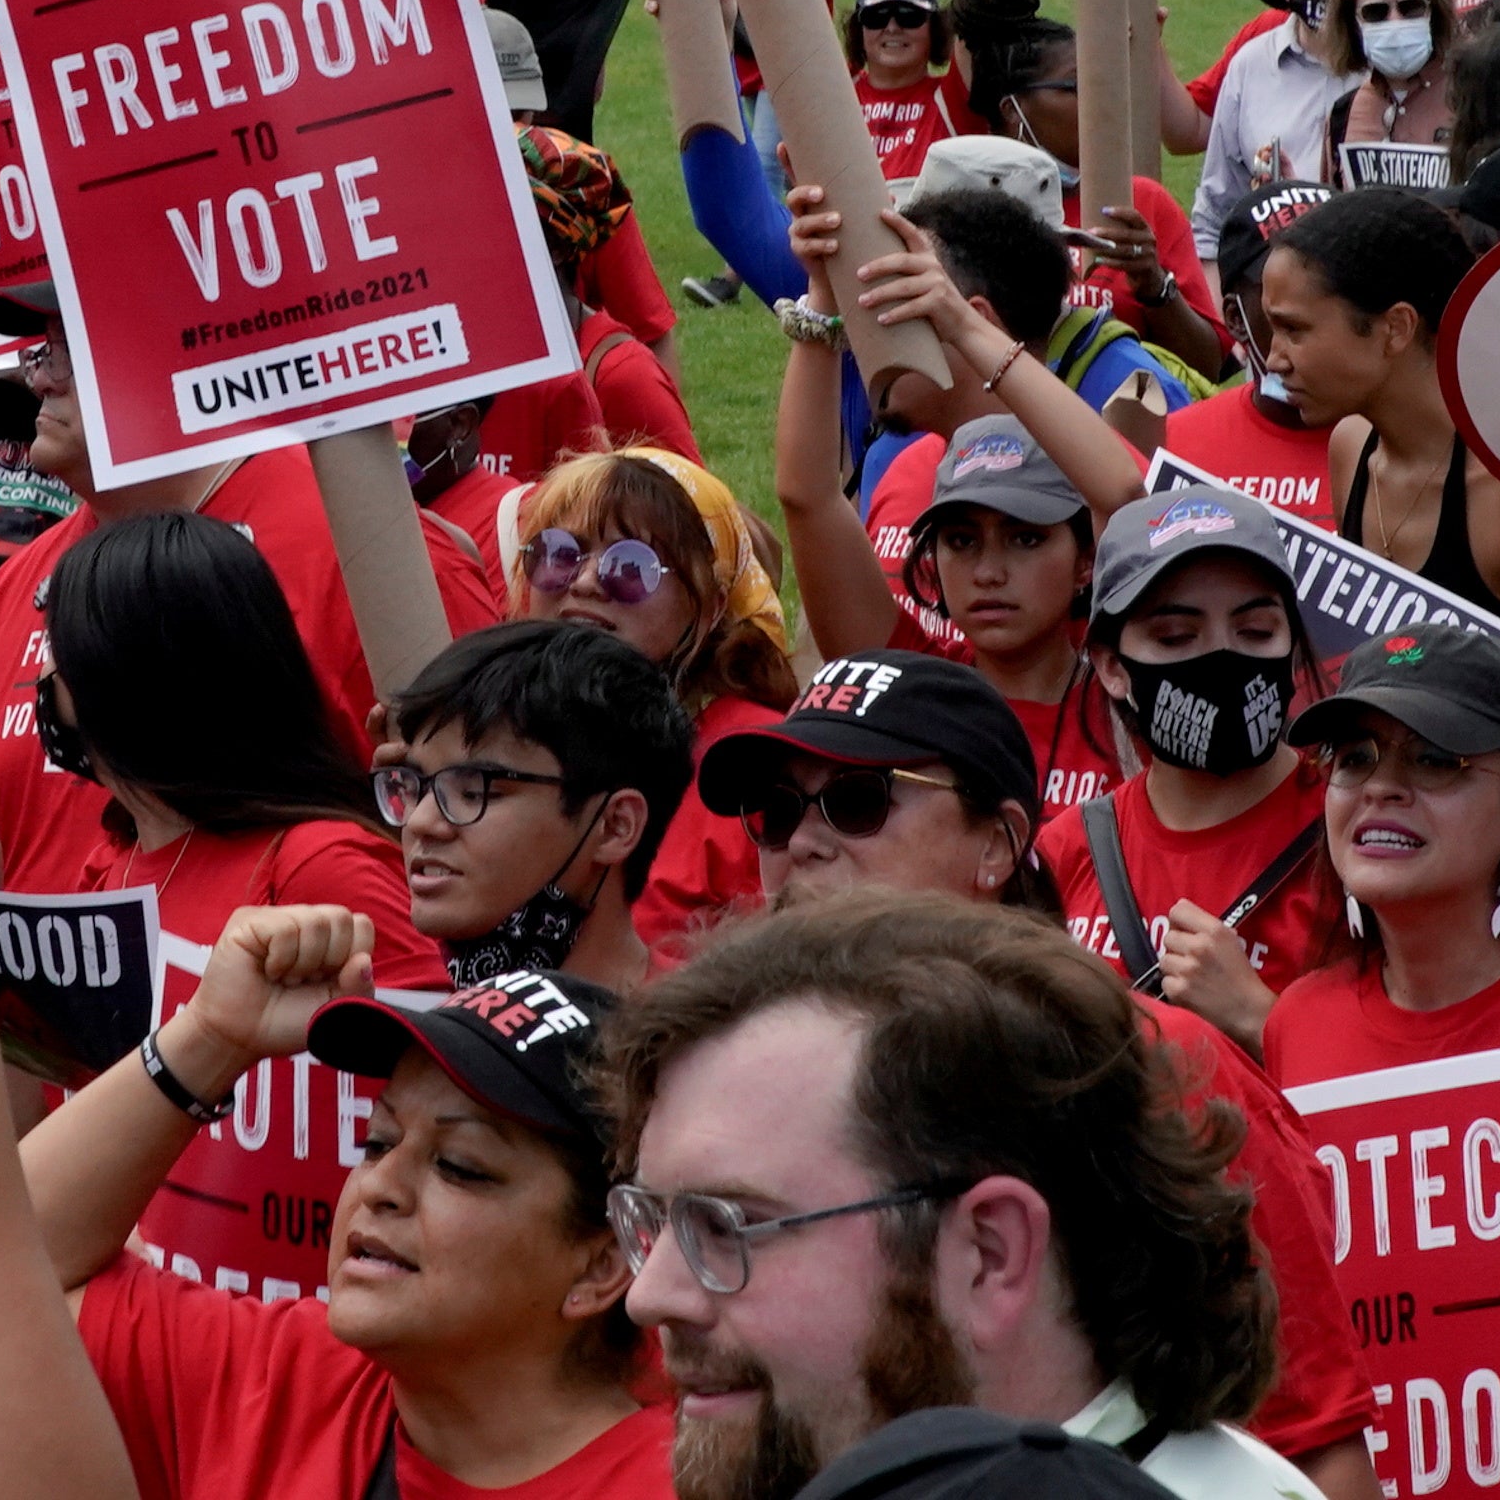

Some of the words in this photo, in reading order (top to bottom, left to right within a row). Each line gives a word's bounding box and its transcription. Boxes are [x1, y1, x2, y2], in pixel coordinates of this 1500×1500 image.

[231, 120, 279, 166] TO
[1357, 150, 1378, 182] DC
[166, 156, 399, 303] VOTE
[180, 268, 430, 351] #FreedomRide2021
[193, 320, 449, 415] UNITEHERE!
[1153, 703, 1212, 752] VOTERS
[262, 1192, 330, 1247] OUR
[1352, 1291, 1417, 1350] OUR
